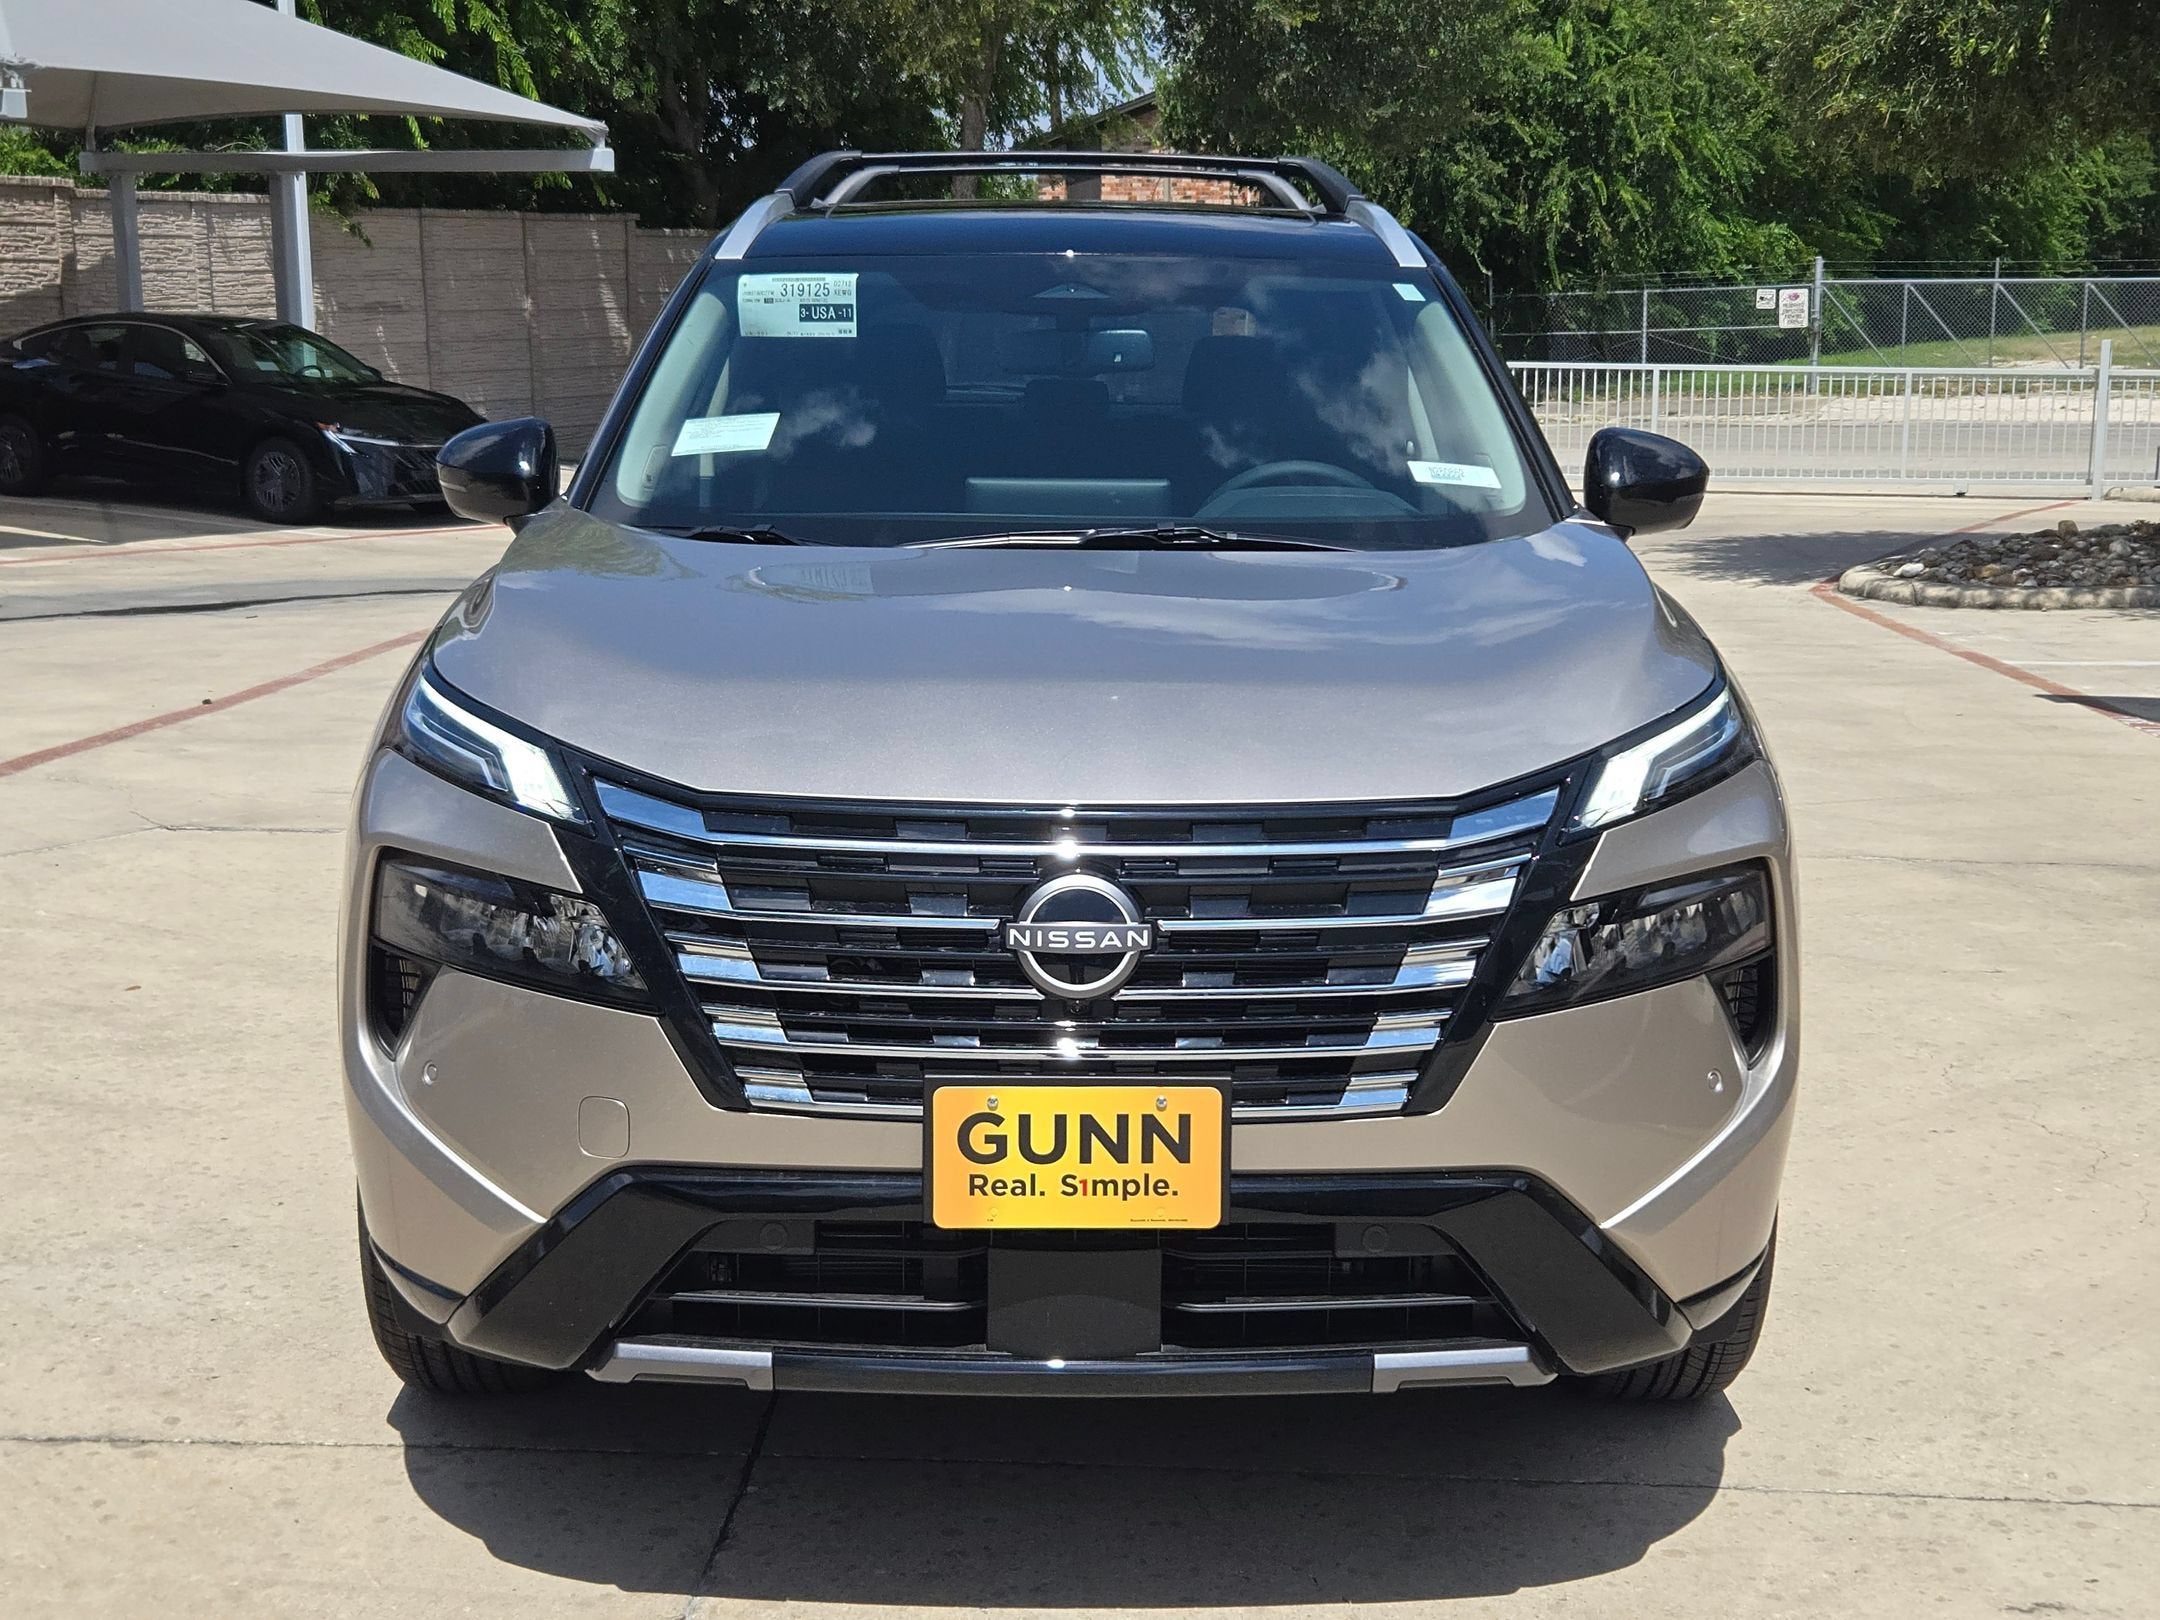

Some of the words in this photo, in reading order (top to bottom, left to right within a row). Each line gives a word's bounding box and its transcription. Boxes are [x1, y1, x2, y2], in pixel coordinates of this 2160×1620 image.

[780, 282, 831, 298] 319125
[800, 308, 810, 318] 3-
[812, 306, 836, 320] USA
[838, 308, 852, 318] -11
[1009, 928, 1149, 949] NISSAN
[957, 1111, 1192, 1165] GUNN
[968, 1173, 1046, 1197] Real.
